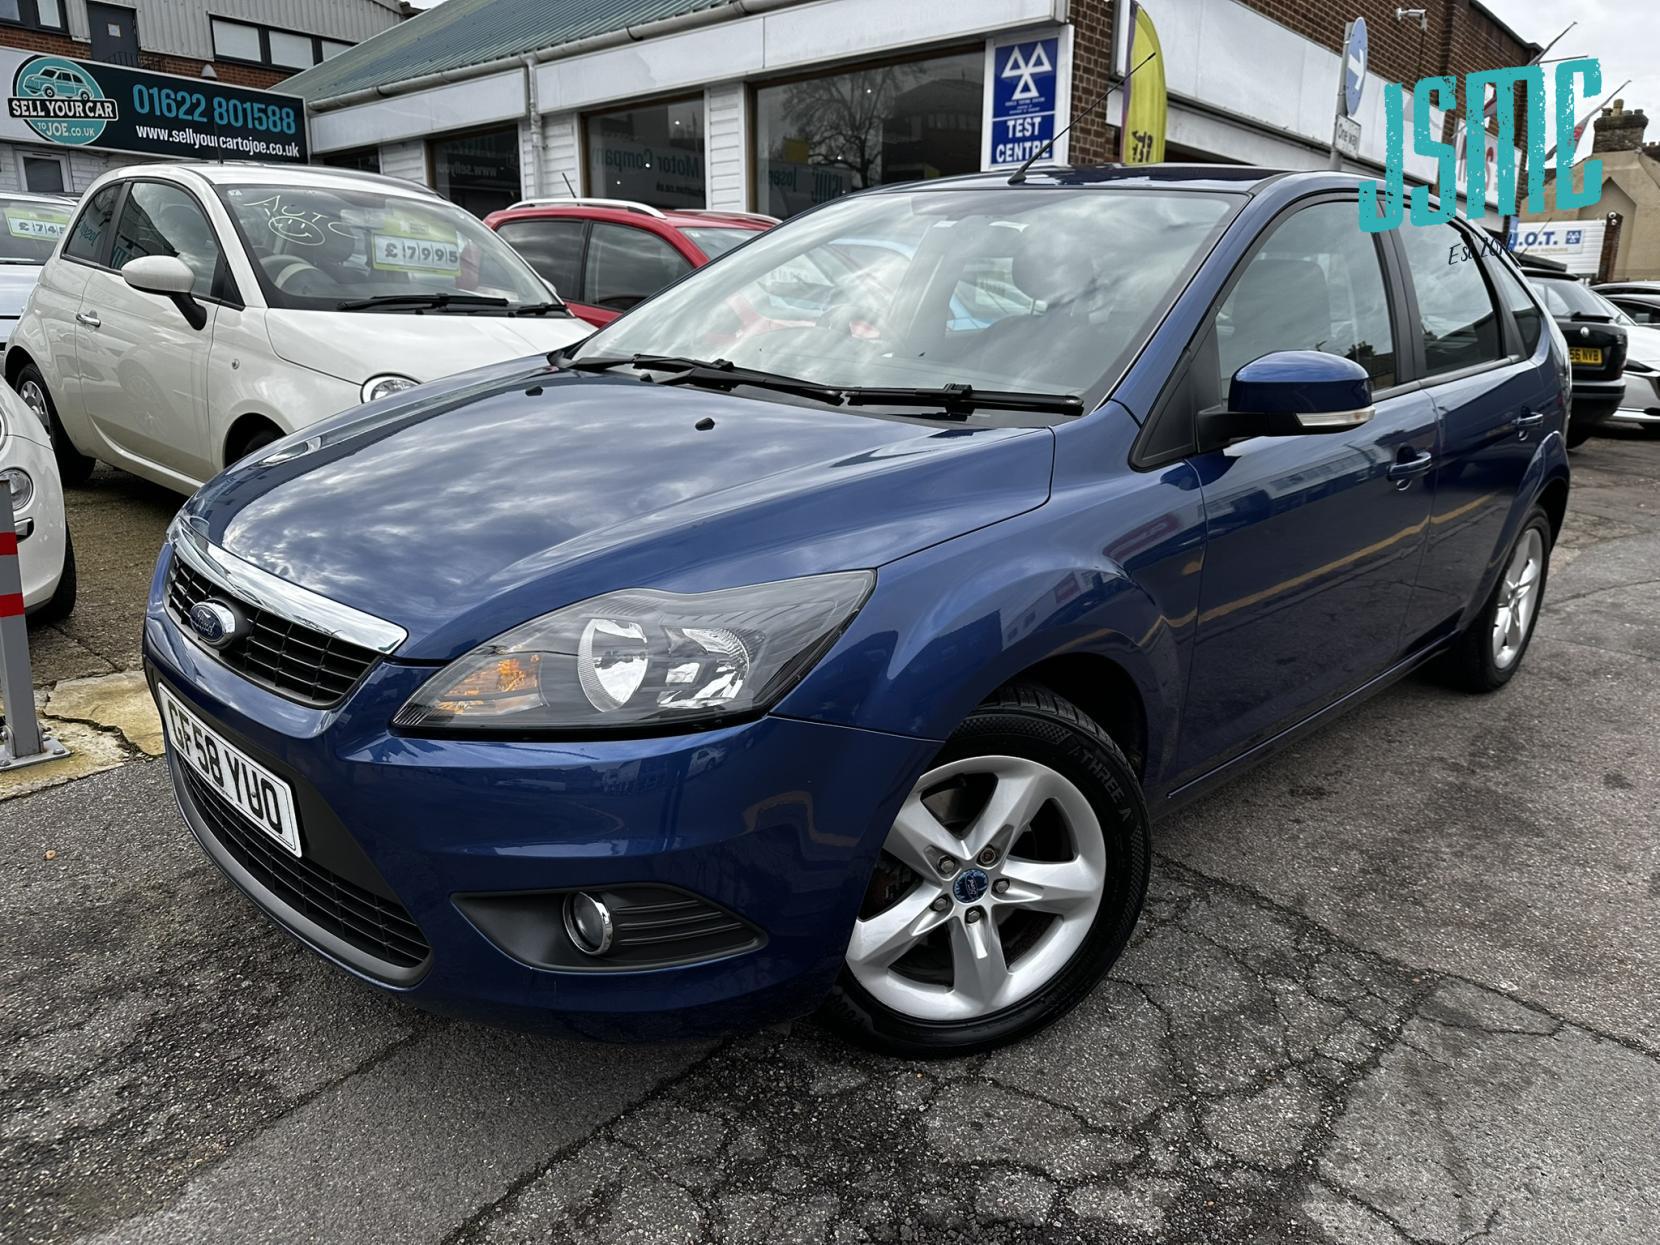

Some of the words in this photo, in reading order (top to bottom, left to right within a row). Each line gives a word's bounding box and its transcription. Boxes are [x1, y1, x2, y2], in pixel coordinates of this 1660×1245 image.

[12, 100, 45, 116] SELL
[45, 101, 84, 117] YOUR
[85, 102, 114, 118] CAR
[132, 84, 207, 122] 01622
[213, 97, 296, 134] 801588
[1007, 116, 1042, 138] TEST
[996, 140, 1051, 162] CENTRE
[224, 749, 284, 835] YUO
